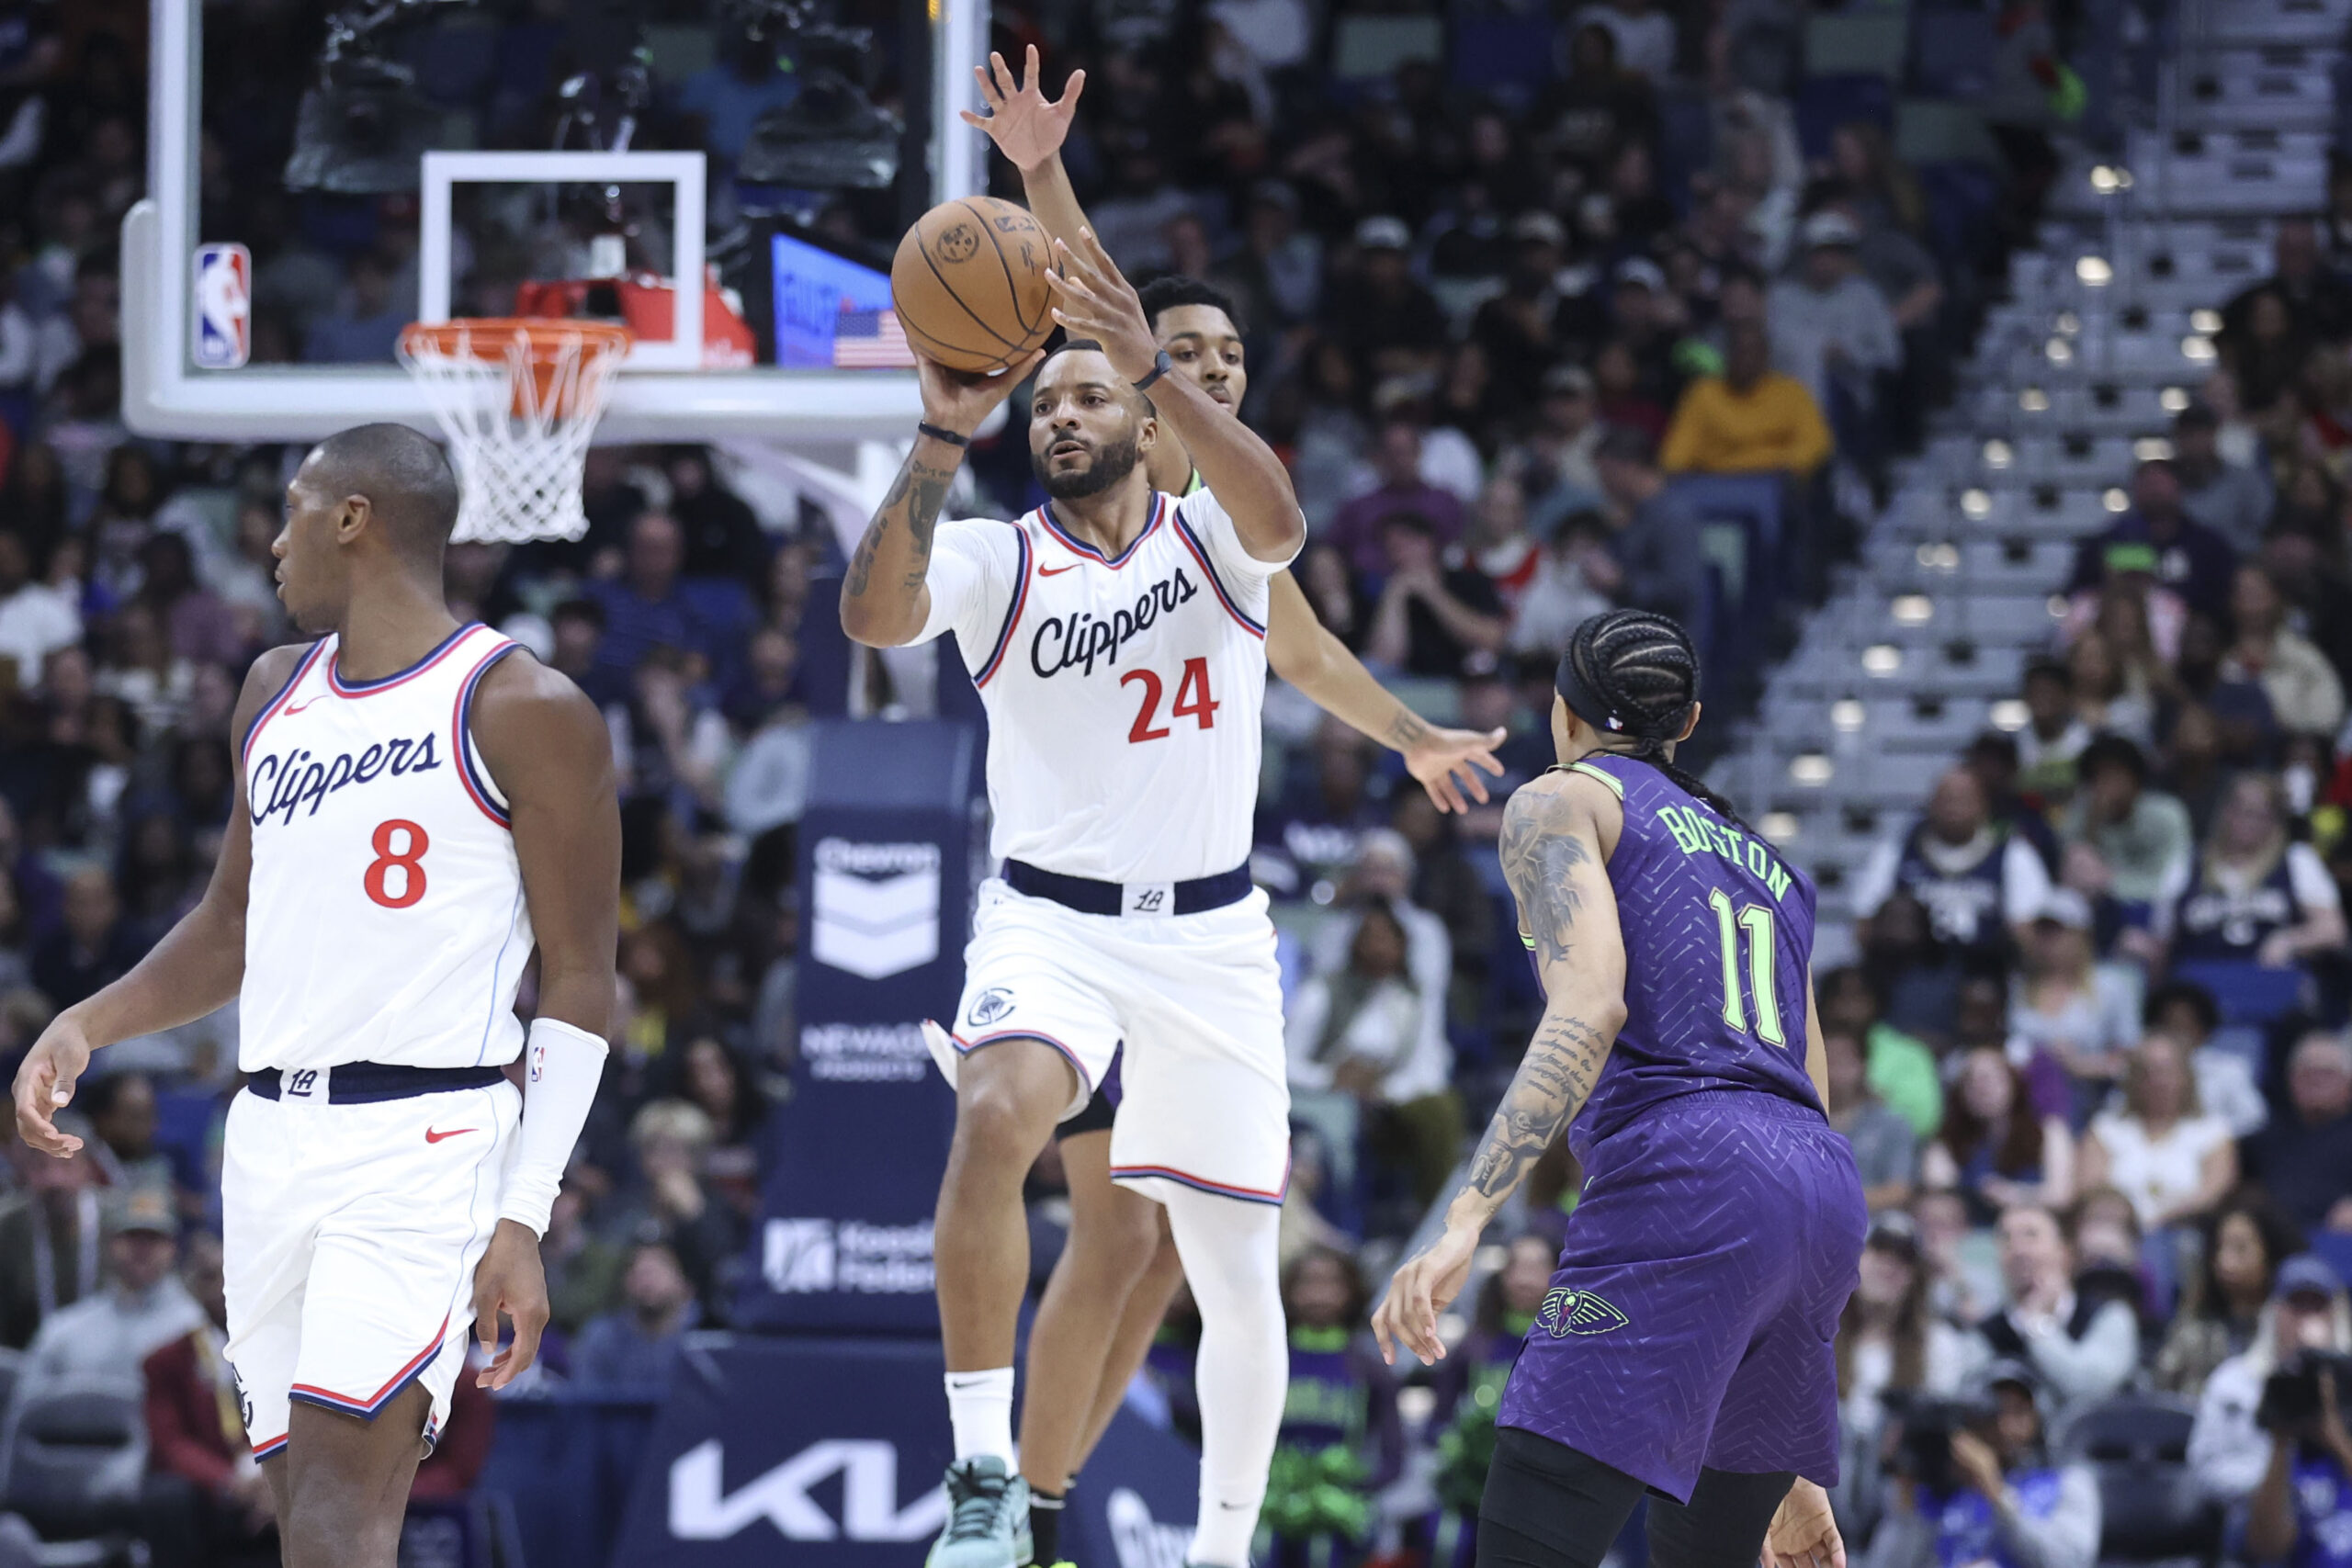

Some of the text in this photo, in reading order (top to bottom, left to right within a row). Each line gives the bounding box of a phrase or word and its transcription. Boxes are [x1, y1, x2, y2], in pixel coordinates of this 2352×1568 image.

[1031, 568, 1197, 678] Clippers
[1120, 657, 1220, 743] 24
[251, 731, 443, 827] Clippers
[364, 818, 429, 908] 8
[1657, 806, 1792, 903] BOSTON
[1708, 886, 1786, 1048] 11
[288, 1068, 318, 1098] LA
